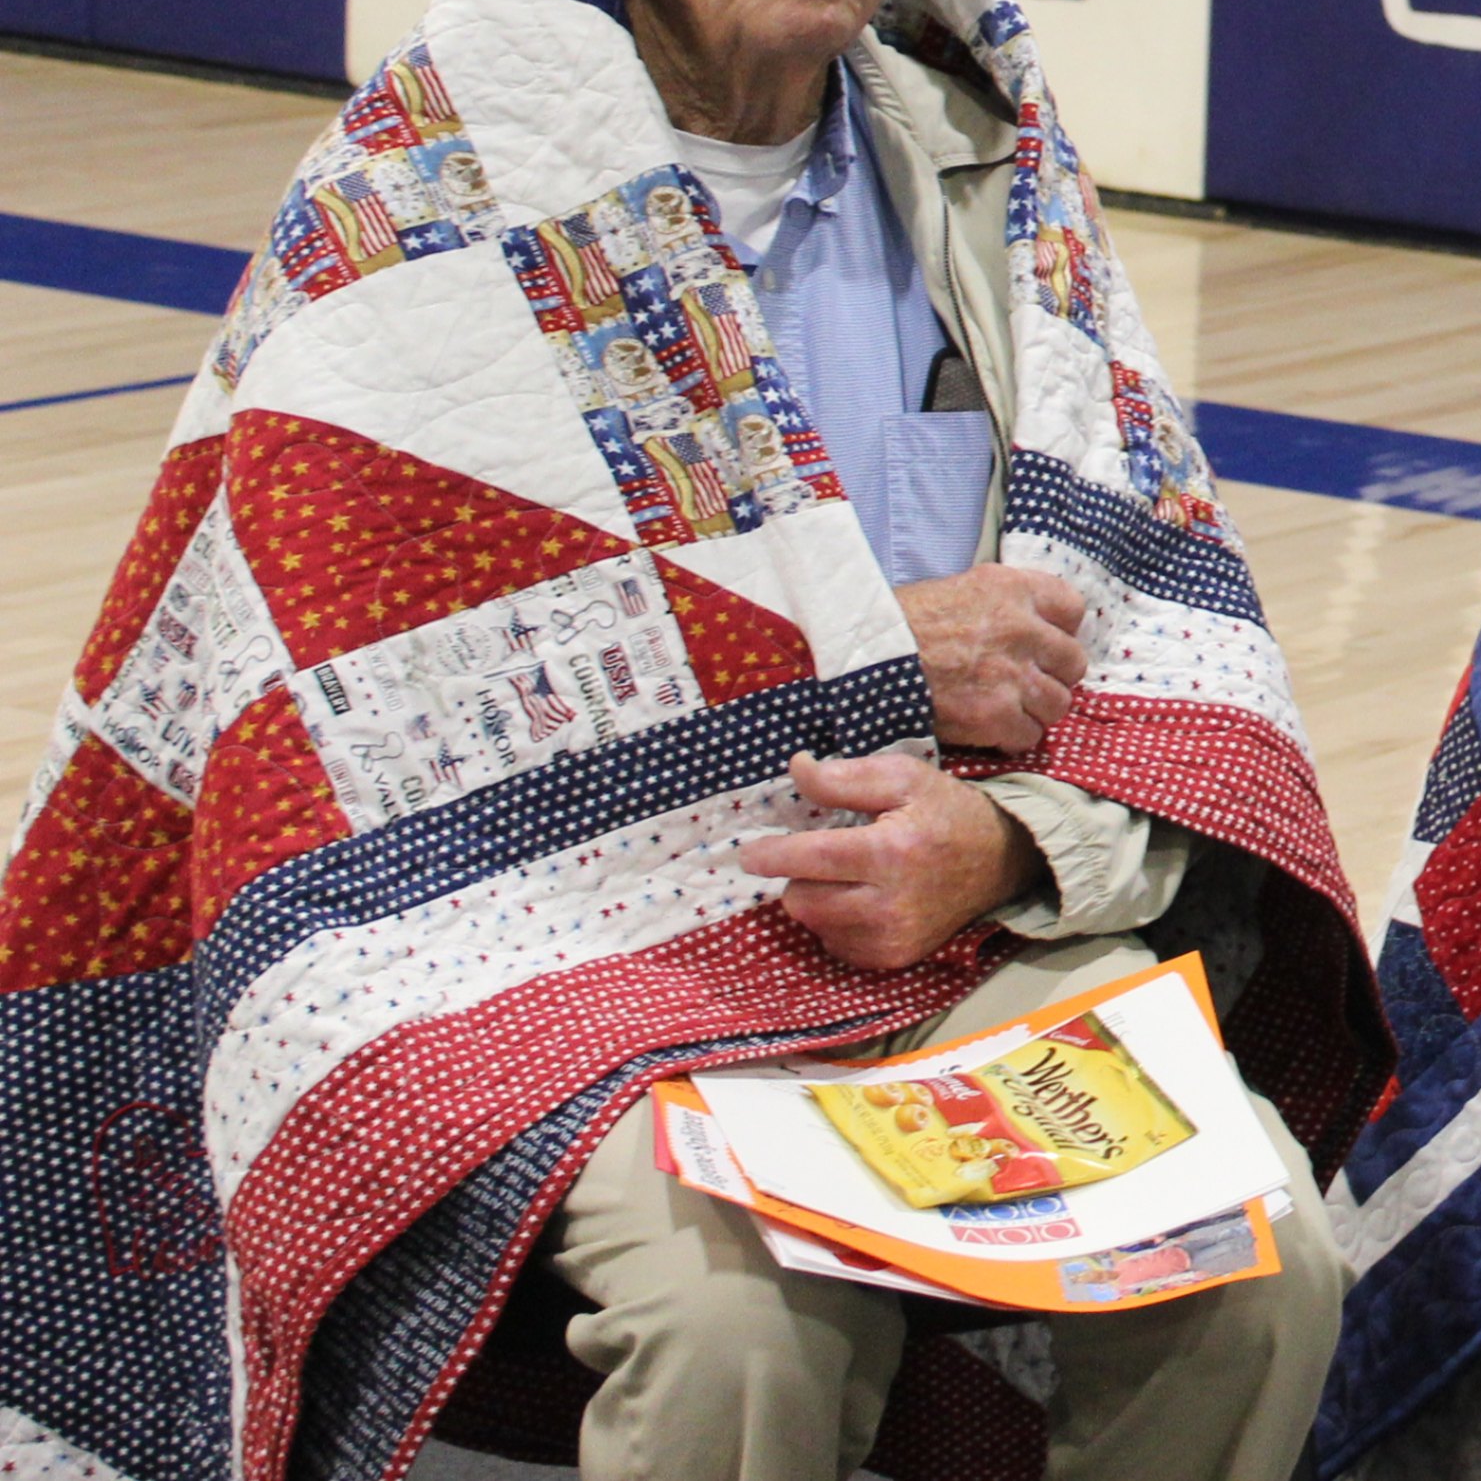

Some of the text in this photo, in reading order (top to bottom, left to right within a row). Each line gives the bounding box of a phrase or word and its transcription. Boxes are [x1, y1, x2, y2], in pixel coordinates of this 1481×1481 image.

[315, 664, 351, 715] BRAVERY
[599, 642, 640, 707] USA
[475, 687, 517, 768] HONOR
[1022, 1046, 1129, 1161] Werther's
